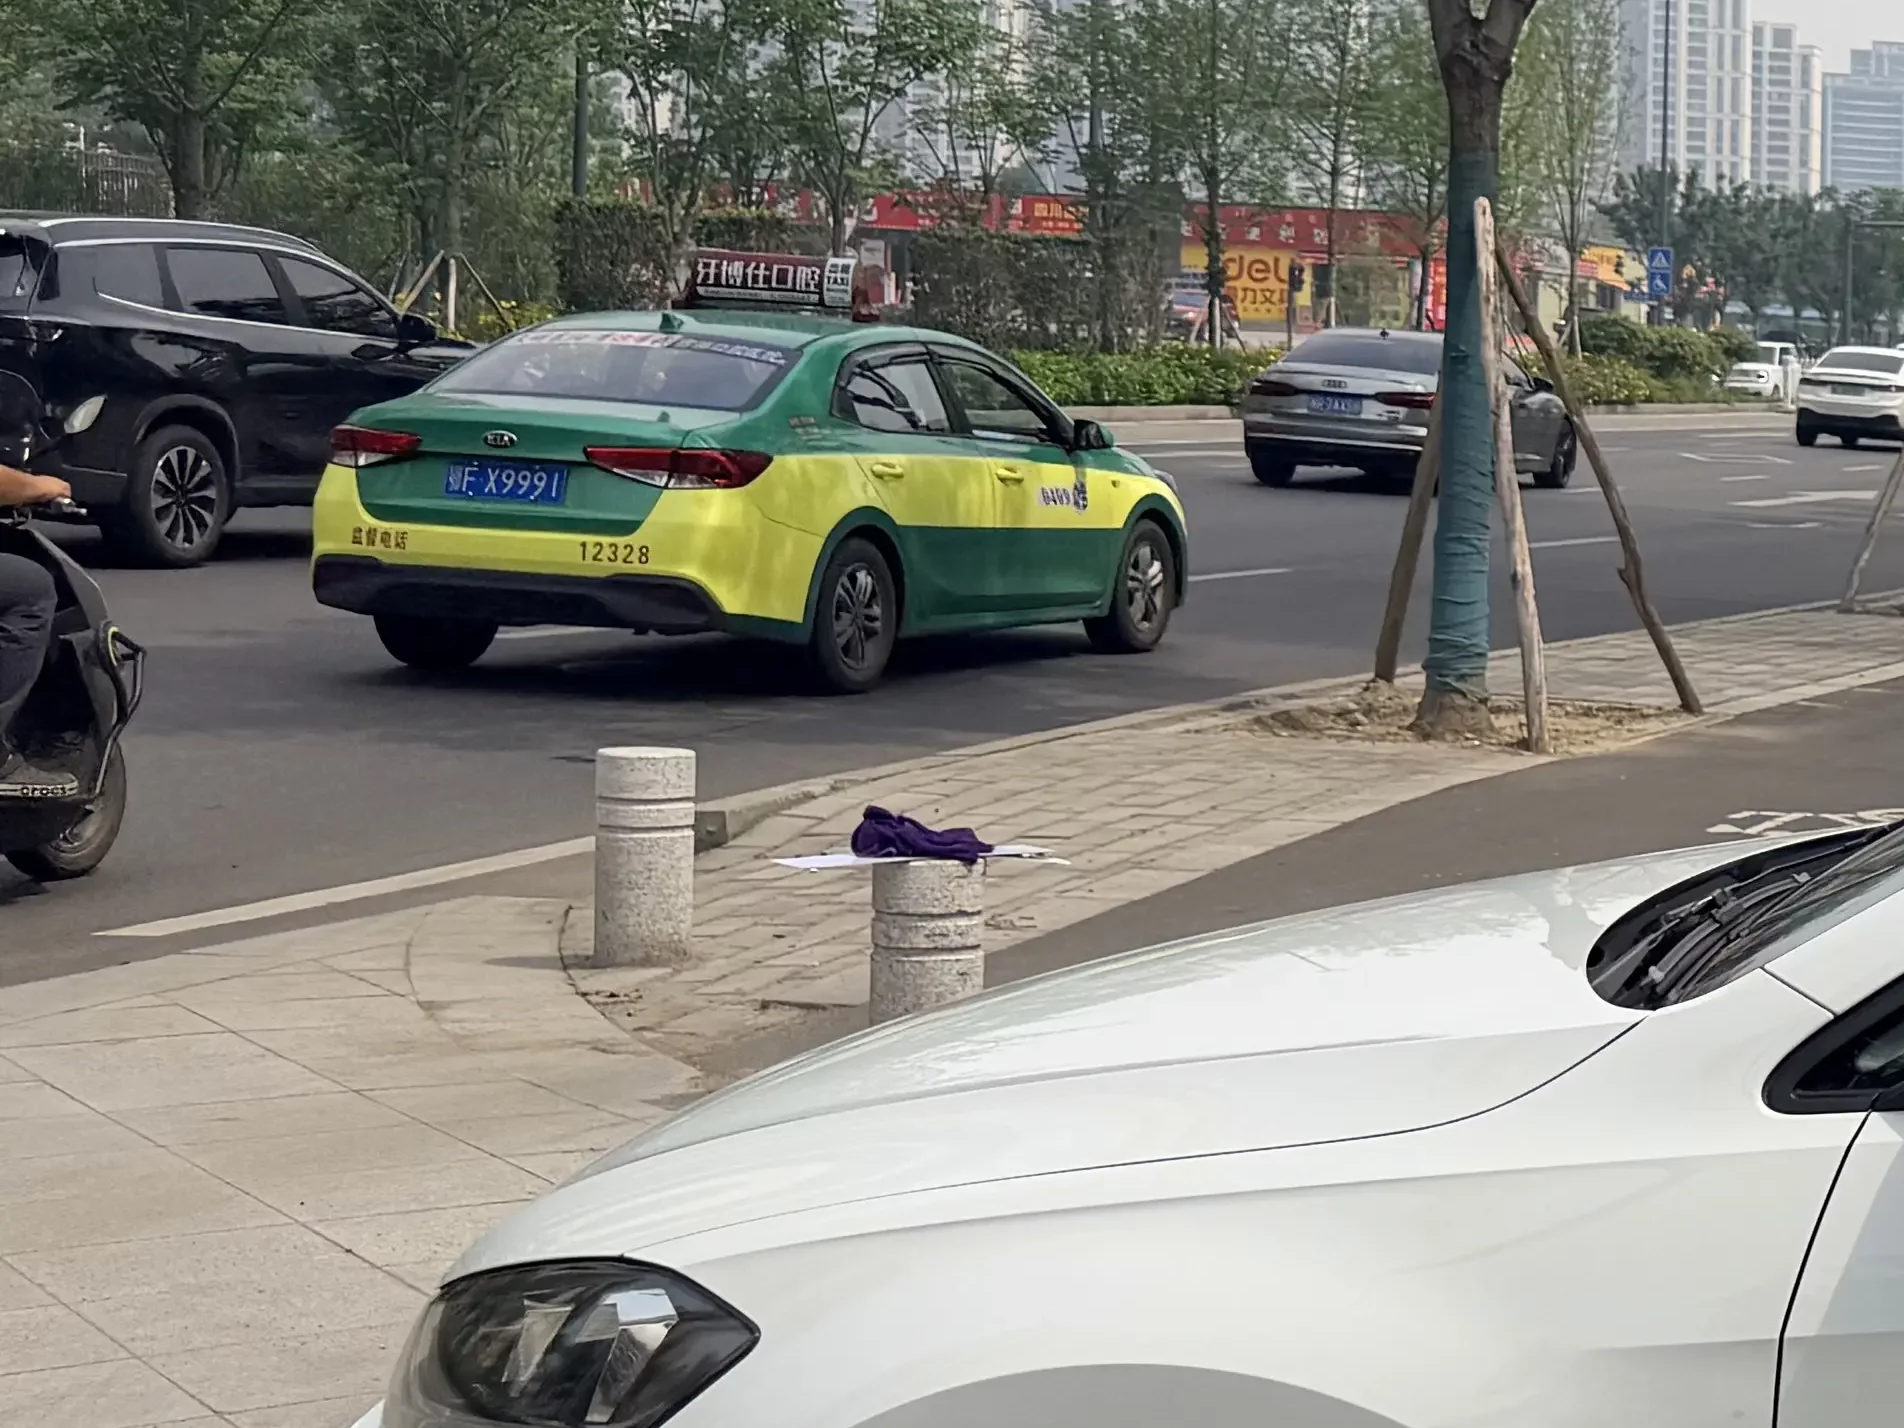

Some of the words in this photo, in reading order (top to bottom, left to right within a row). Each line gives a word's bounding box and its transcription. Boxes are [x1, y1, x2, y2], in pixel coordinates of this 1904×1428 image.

[696, 258, 821, 292] 牙博仕口腔
[1223, 254, 1295, 284] del
[487, 434, 511, 446] KIA
[352, 526, 409, 551] 监督电话
[579, 541, 650, 565] 12328
